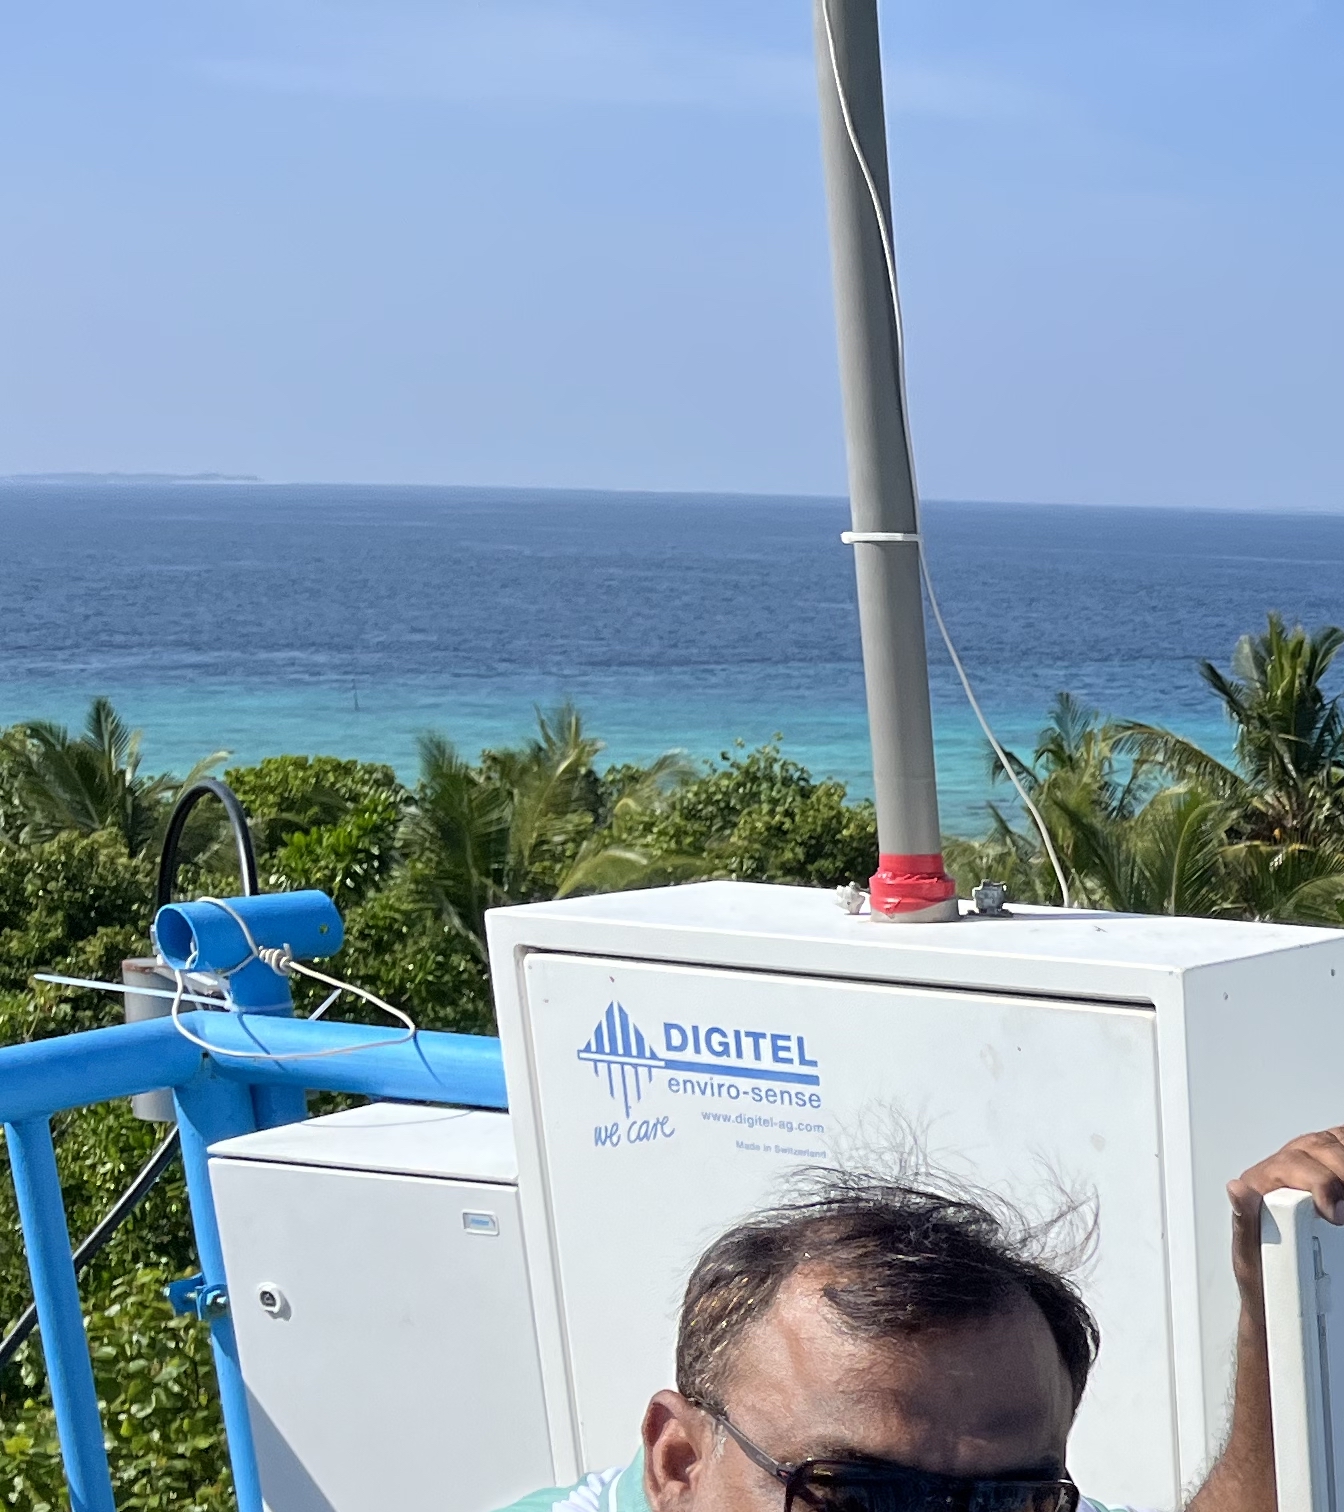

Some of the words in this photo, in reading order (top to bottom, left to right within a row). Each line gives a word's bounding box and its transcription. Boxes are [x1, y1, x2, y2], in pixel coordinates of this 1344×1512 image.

[663, 1021, 819, 1068] DIGITEL
[667, 1076, 822, 1109] enviro-sense
[594, 1122, 621, 1148] we
[627, 1115, 675, 1144] care
[701, 1110, 825, 1134] www.digitel-ag.com
[736, 1140, 761, 1151] Made
[763, 1144, 772, 1152] in
[774, 1145, 827, 1159] Switzerland
